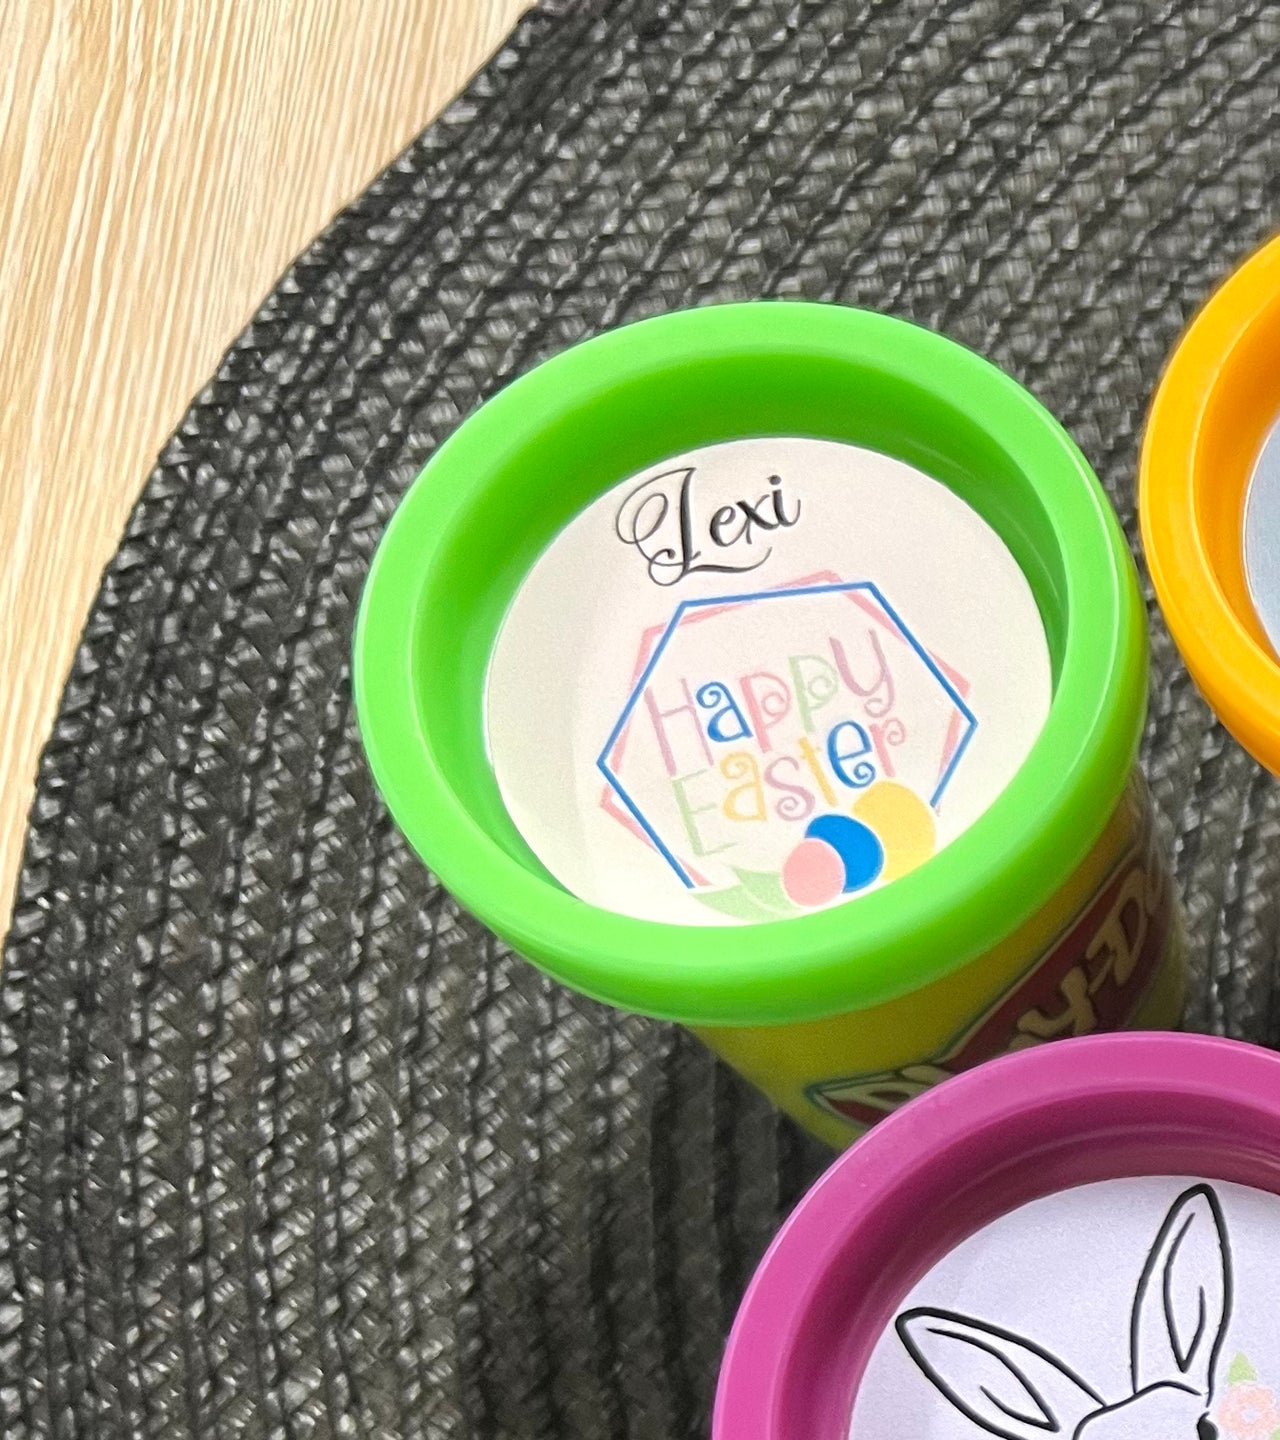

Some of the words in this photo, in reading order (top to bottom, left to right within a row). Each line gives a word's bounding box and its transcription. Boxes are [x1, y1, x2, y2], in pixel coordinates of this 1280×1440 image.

[615, 467, 801, 586] Lexi
[644, 629, 896, 777] Happy
[671, 716, 907, 857] Easter
